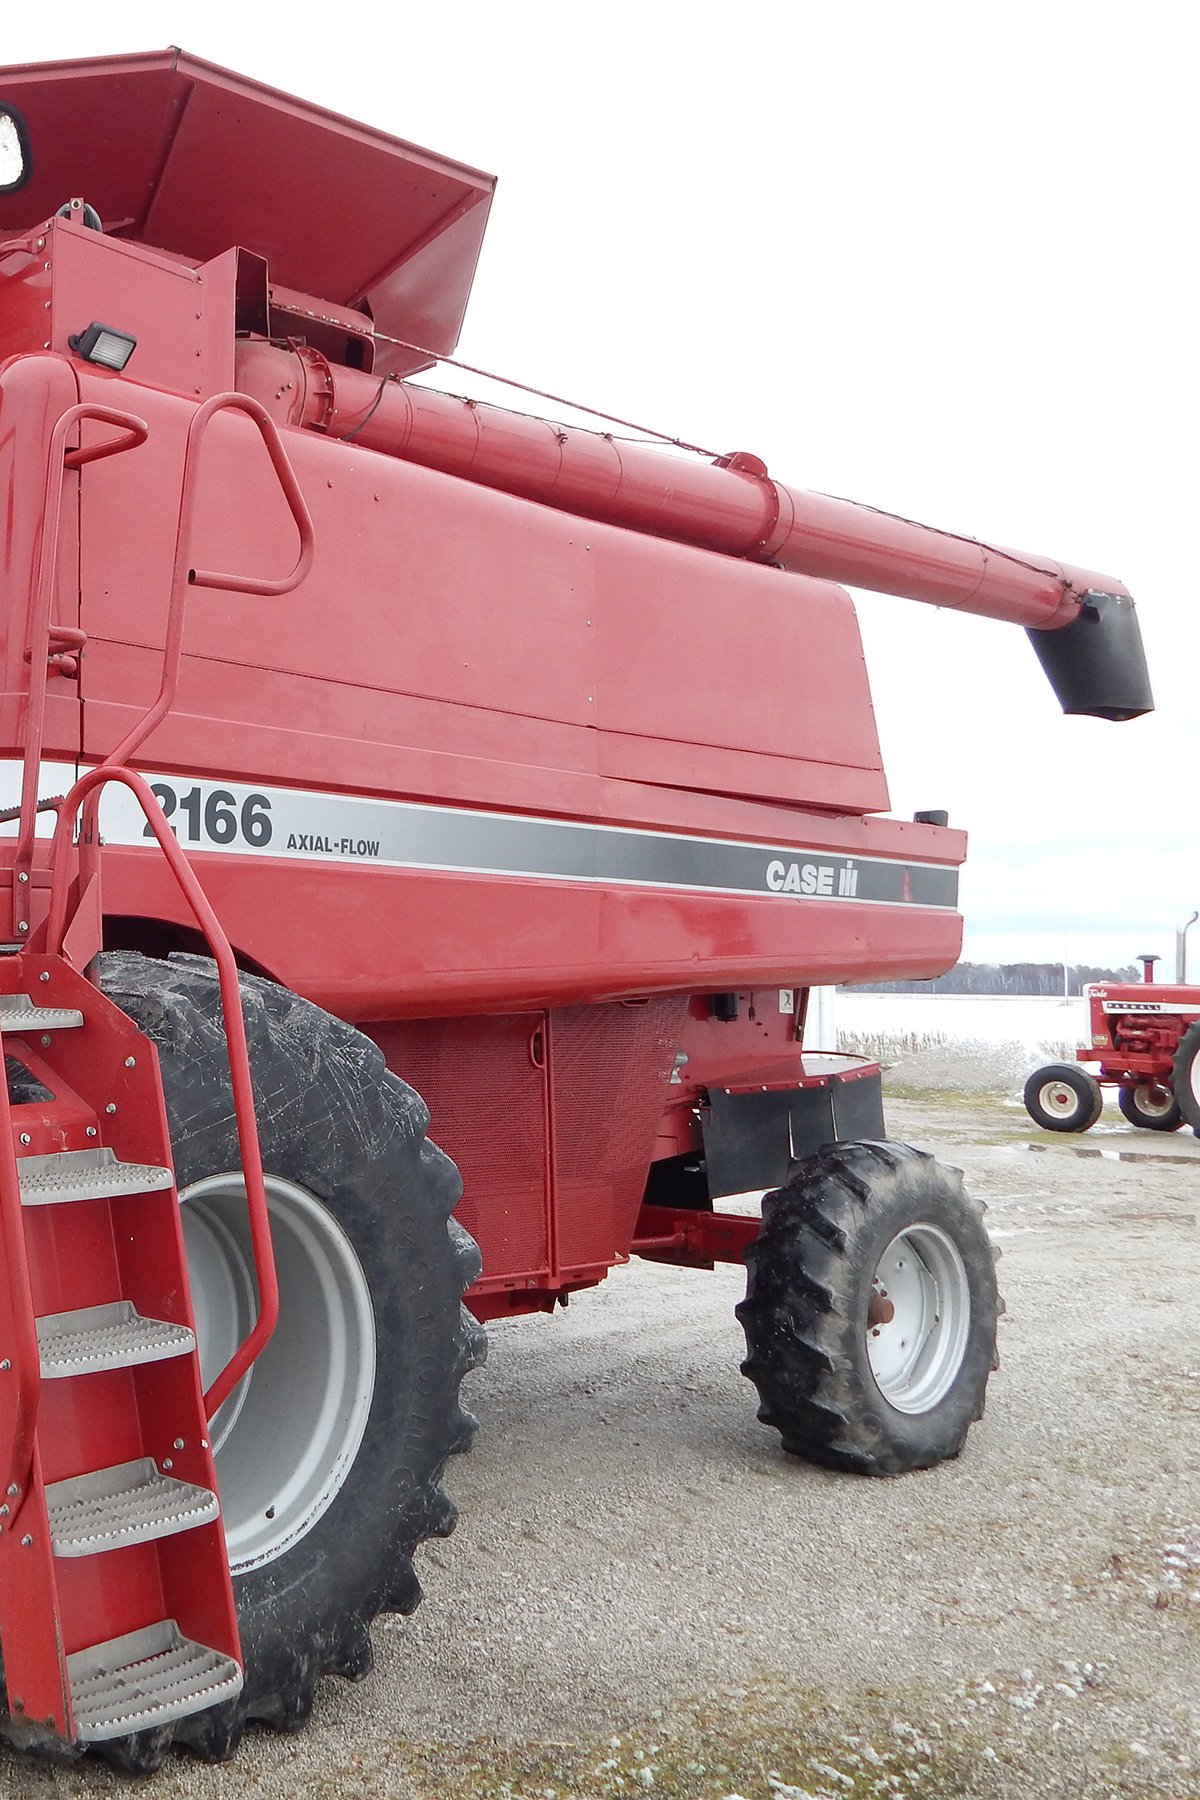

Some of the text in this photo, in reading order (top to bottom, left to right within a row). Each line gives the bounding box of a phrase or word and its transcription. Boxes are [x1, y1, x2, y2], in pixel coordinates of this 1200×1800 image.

[143, 783, 272, 847] 2166
[287, 833, 380, 857] AXIAL-FLOW
[766, 860, 834, 894] CASE
[1107, 1002, 1160, 1010] FARMALL
